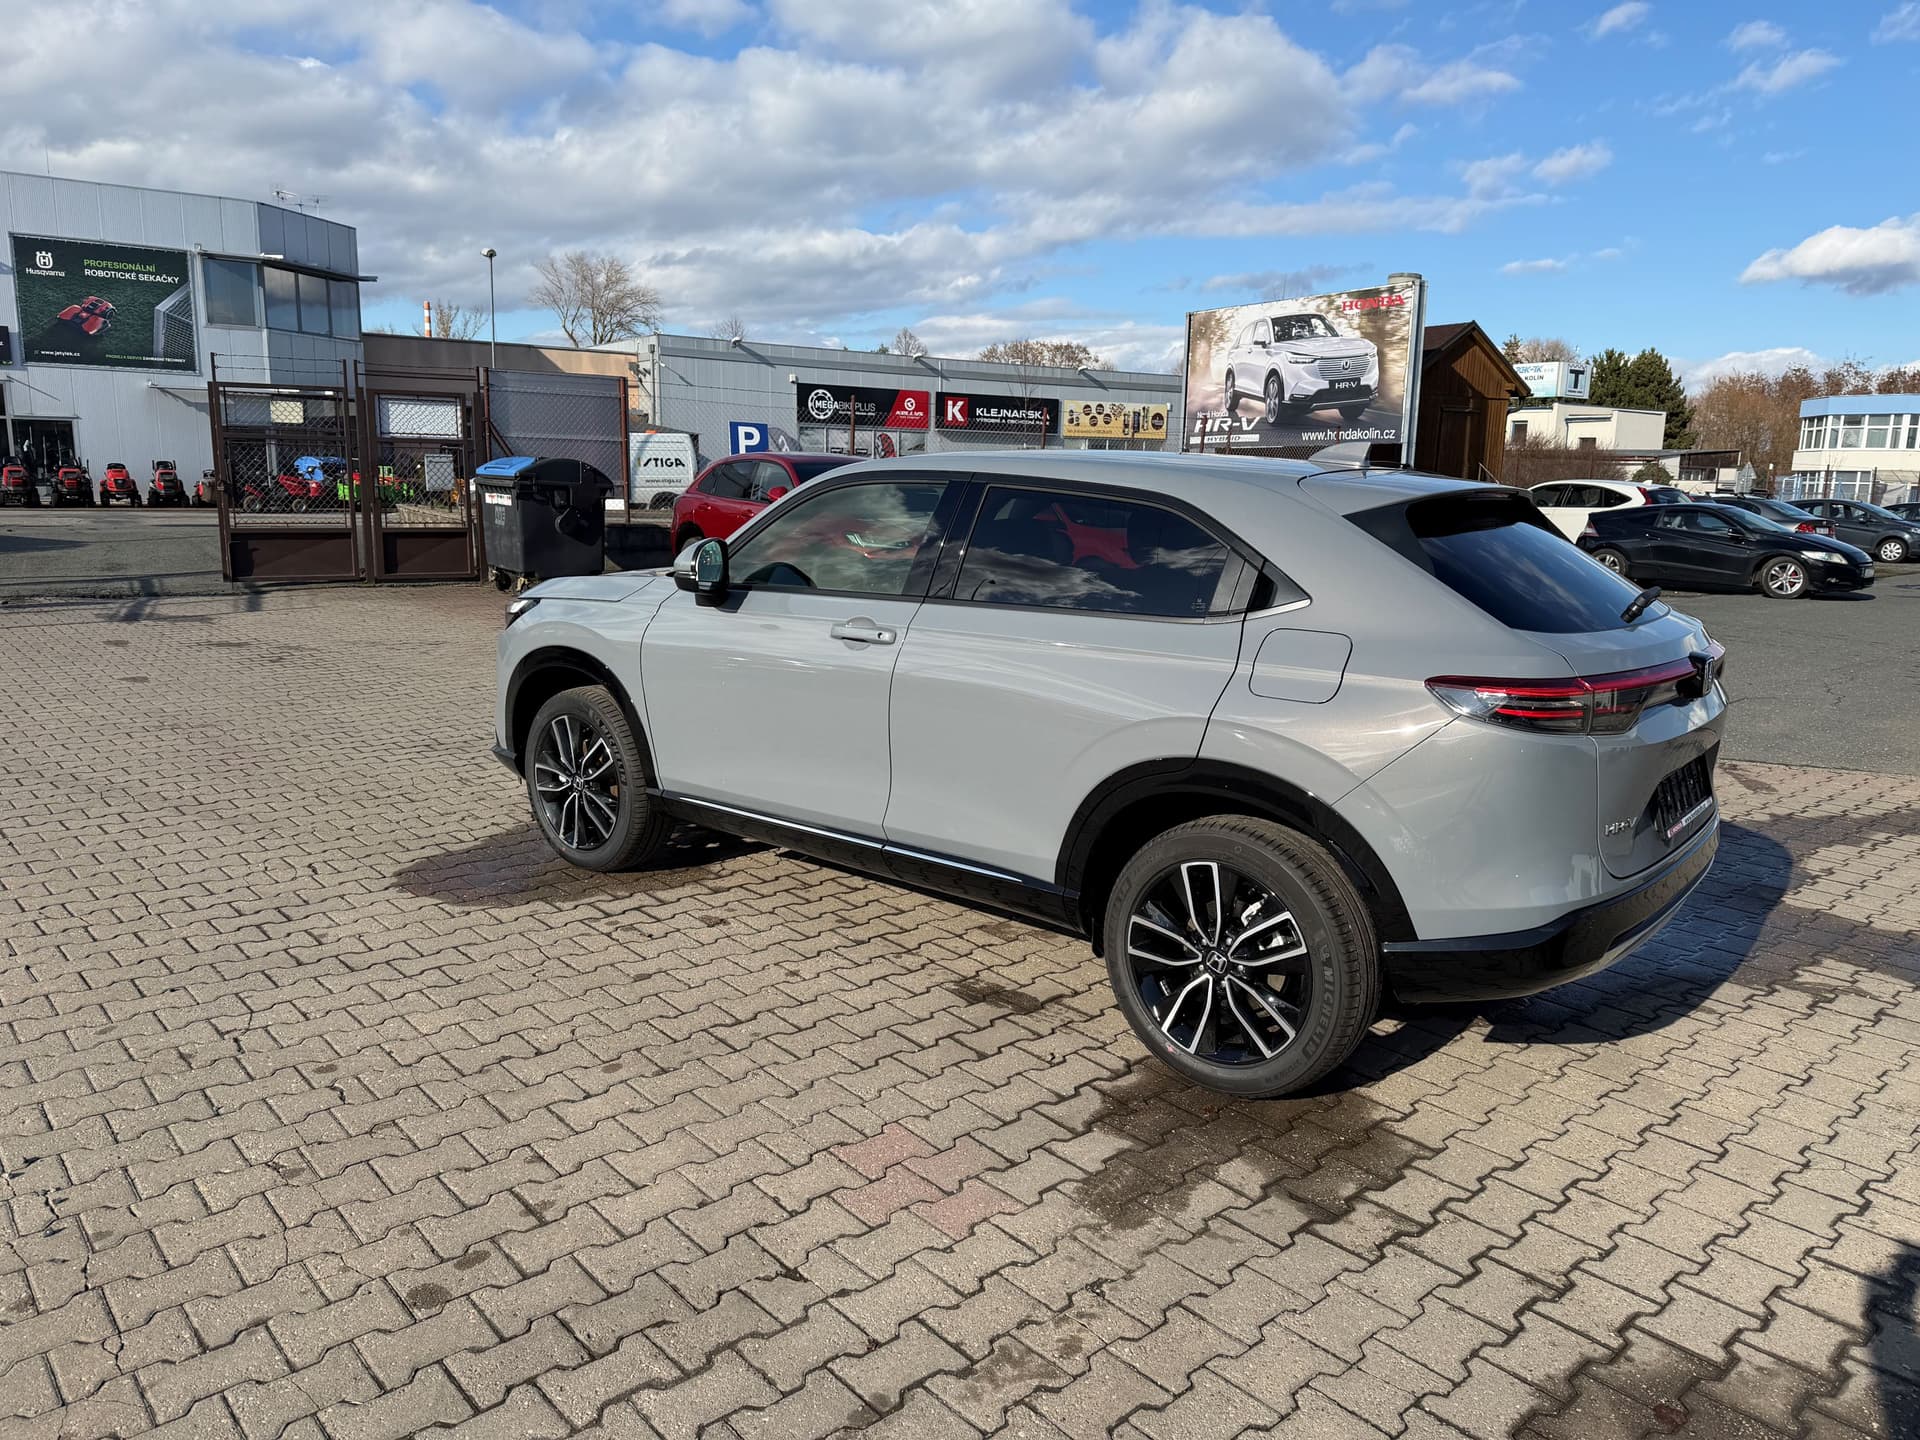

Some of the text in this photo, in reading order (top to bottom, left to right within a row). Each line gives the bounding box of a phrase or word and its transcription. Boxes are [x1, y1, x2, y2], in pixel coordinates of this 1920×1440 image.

[25, 267, 66, 277] Husqvarna
[83, 258, 156, 273] PROFESIONÁLNÍ
[84, 268, 180, 284] ROBOTICKÉ SEKAČKY
[1341, 294, 1405, 312] HONDA
[1335, 381, 1358, 390] HR-V
[815, 400, 876, 412] MEGABIKPLUS
[947, 400, 965, 422] K
[1194, 416, 1260, 433] HR-V
[737, 426, 761, 454] P
[643, 457, 686, 468] STIGA
[1604, 817, 1639, 837] HR-V
[1304, 966, 1336, 1059] MICHELIN
